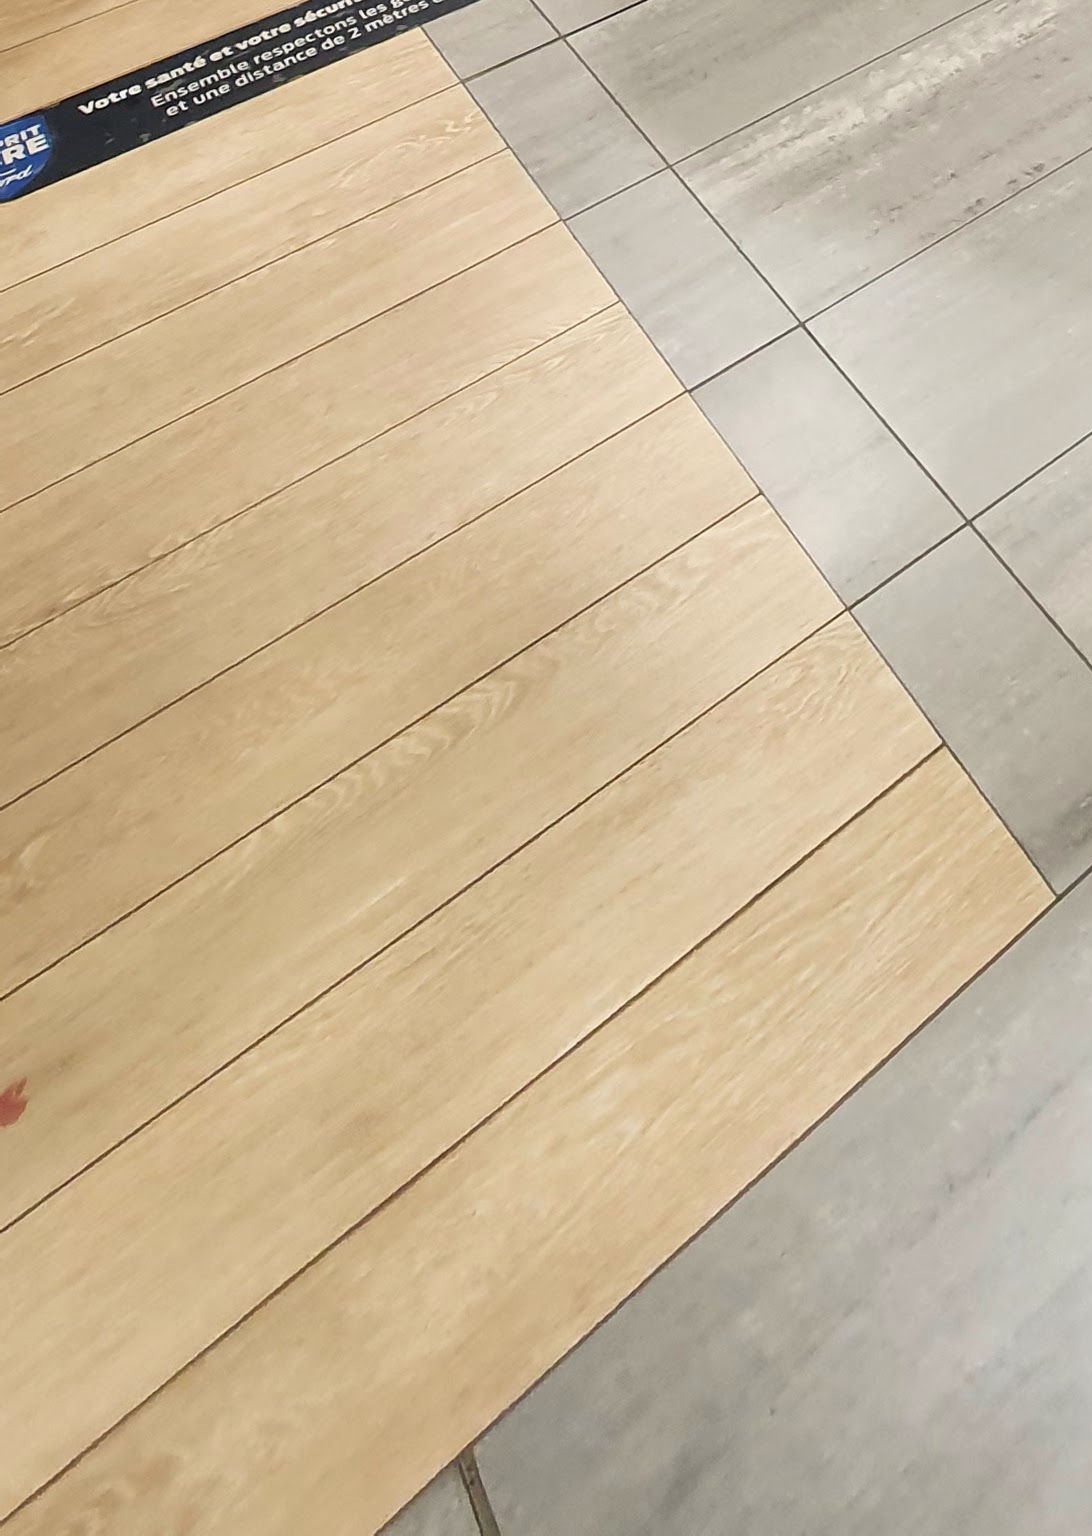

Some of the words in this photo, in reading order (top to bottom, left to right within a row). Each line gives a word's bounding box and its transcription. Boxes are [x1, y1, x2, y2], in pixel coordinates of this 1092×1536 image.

[77, 83, 142, 115] Votre
[145, 55, 207, 90] santé
[209, 46, 234, 63] et
[235, 22, 292, 50] votre
[150, 60, 250, 108] Ensemble
[253, 15, 357, 66] respectons
[358, 3, 388, 20] les
[165, 99, 189, 117] et
[192, 83, 231, 106] une
[234, 47, 318, 88] distance
[320, 35, 345, 51] de
[347, 27, 362, 40] 2
[365, 0, 430, 33] mètres
[0, 134, 49, 165] RE
